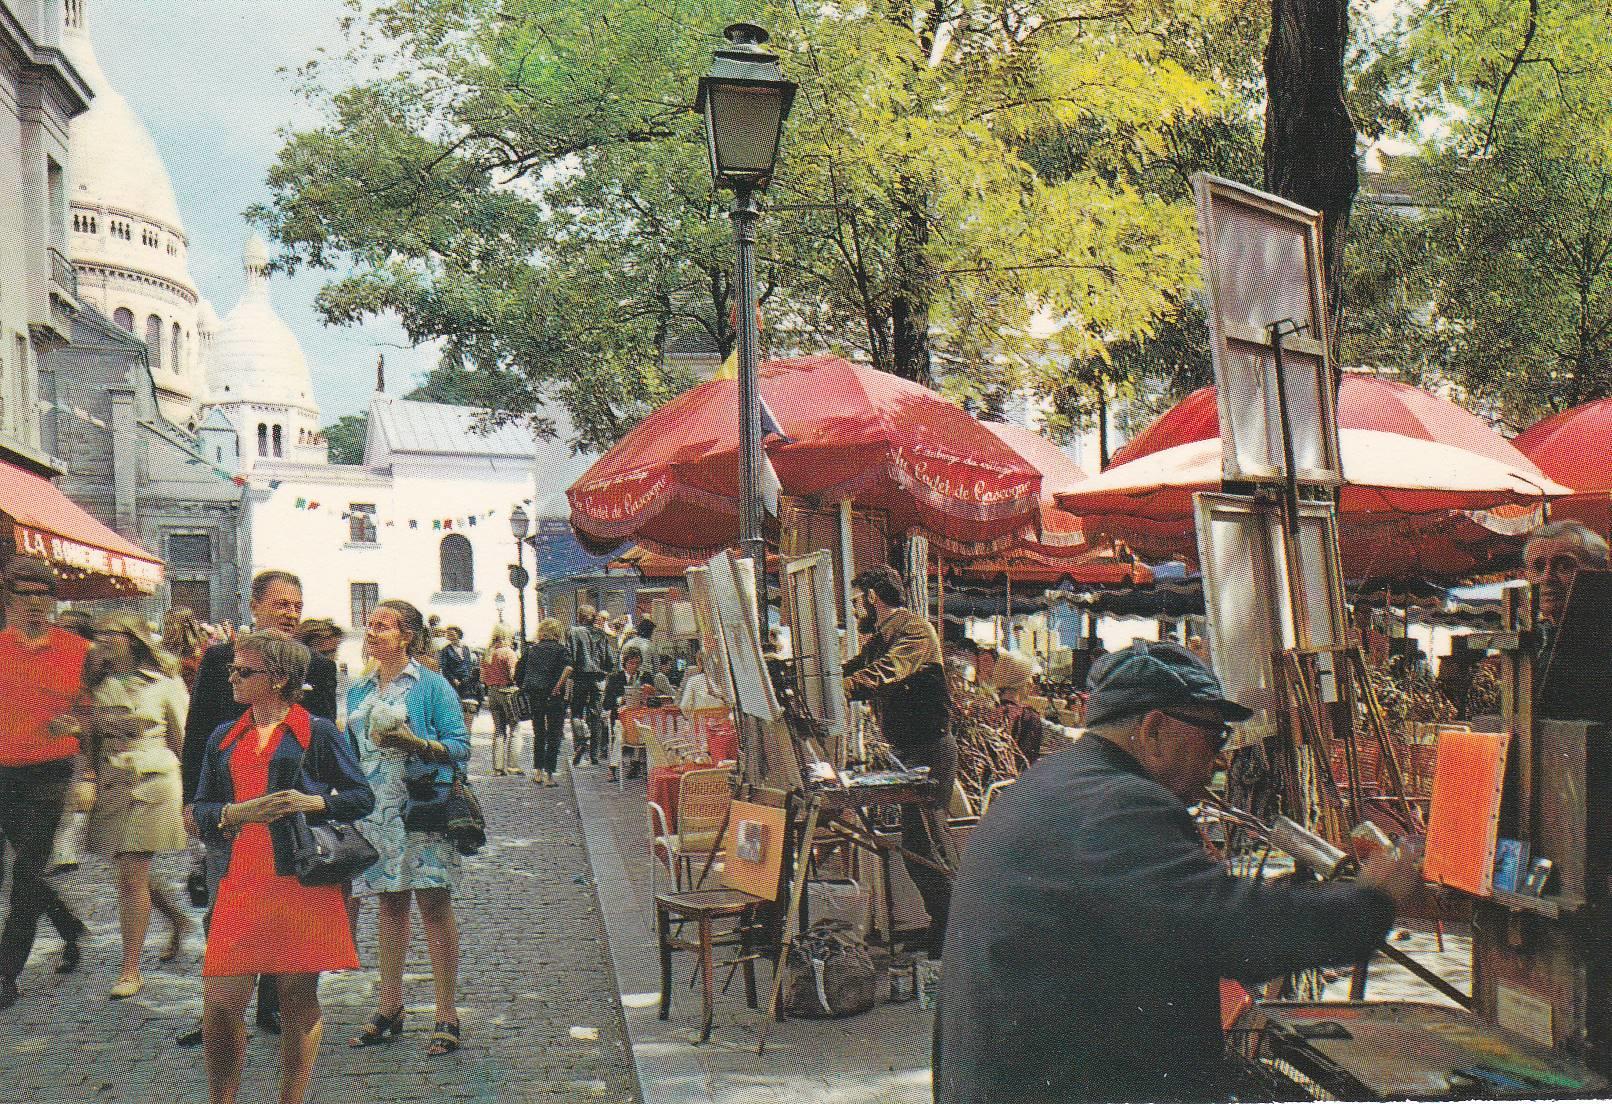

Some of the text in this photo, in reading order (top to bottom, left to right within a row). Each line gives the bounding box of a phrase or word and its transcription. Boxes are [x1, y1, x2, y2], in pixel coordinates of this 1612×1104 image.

[914, 461, 950, 496] Cadet
[955, 483, 970, 500] de
[974, 480, 1031, 505] Gascogne
[23, 529, 46, 557] LA
